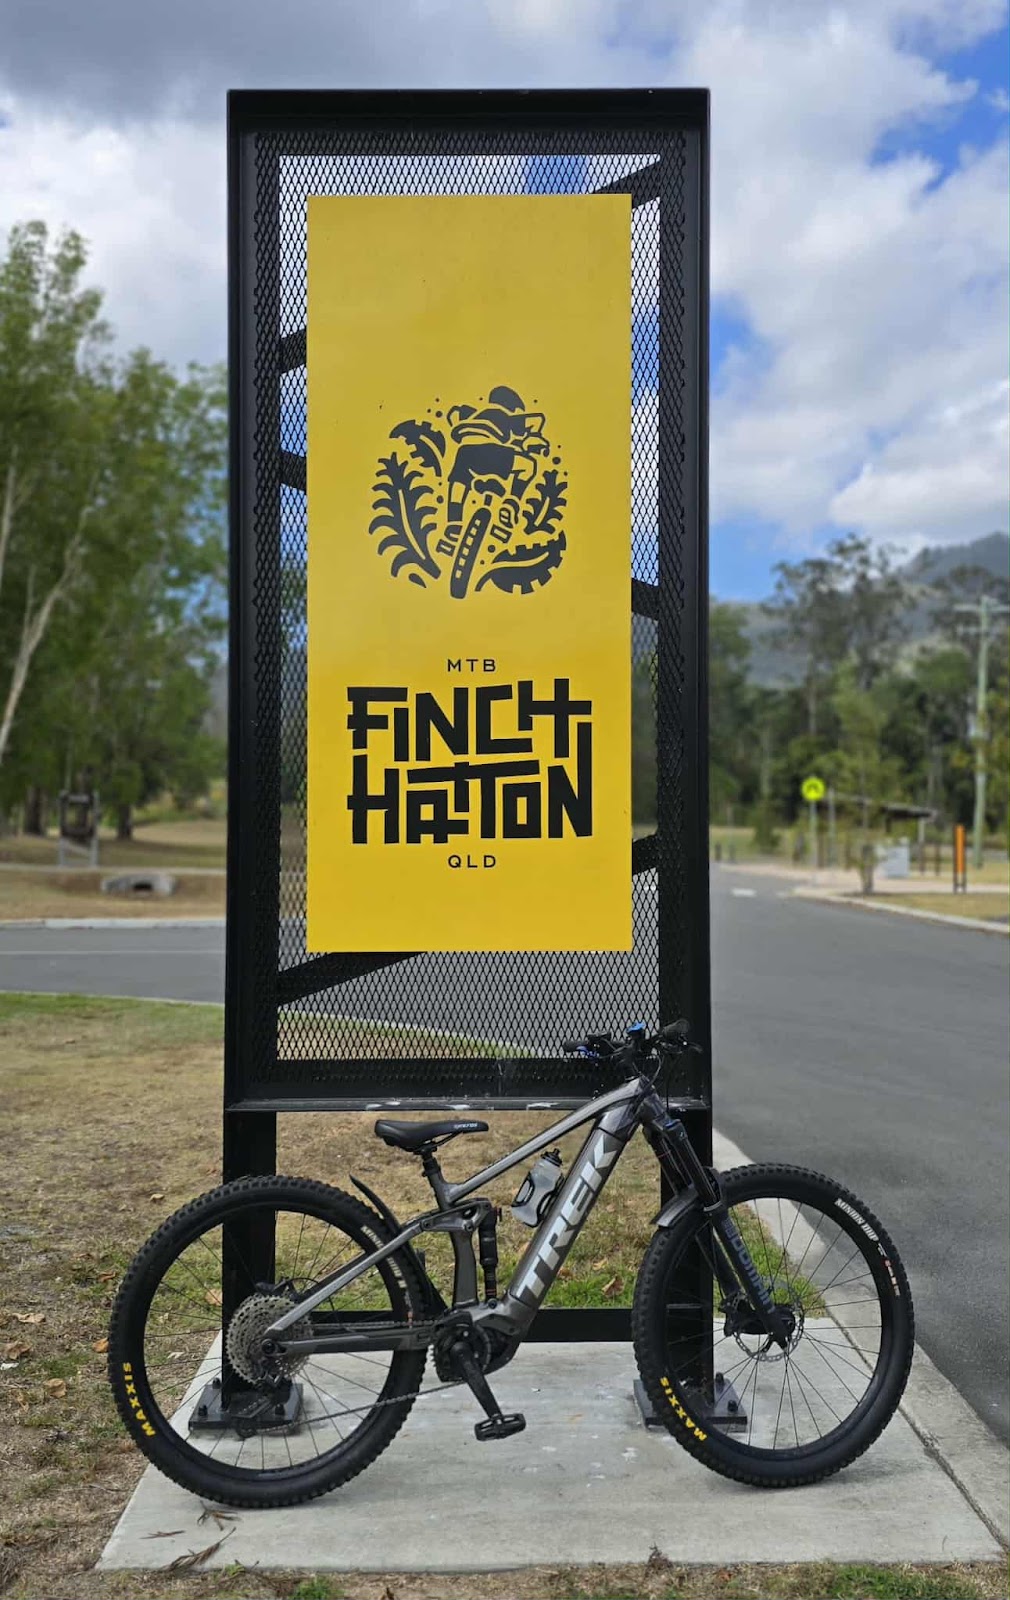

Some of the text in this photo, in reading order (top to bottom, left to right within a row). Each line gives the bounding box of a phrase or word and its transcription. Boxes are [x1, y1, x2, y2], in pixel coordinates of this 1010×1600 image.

[447, 658, 496, 672] MTB
[447, 855, 496, 868] QLD
[516, 1134, 617, 1298] TREK
[123, 1362, 155, 1437] MAXXIS
[660, 1377, 708, 1441] MAXXIS
